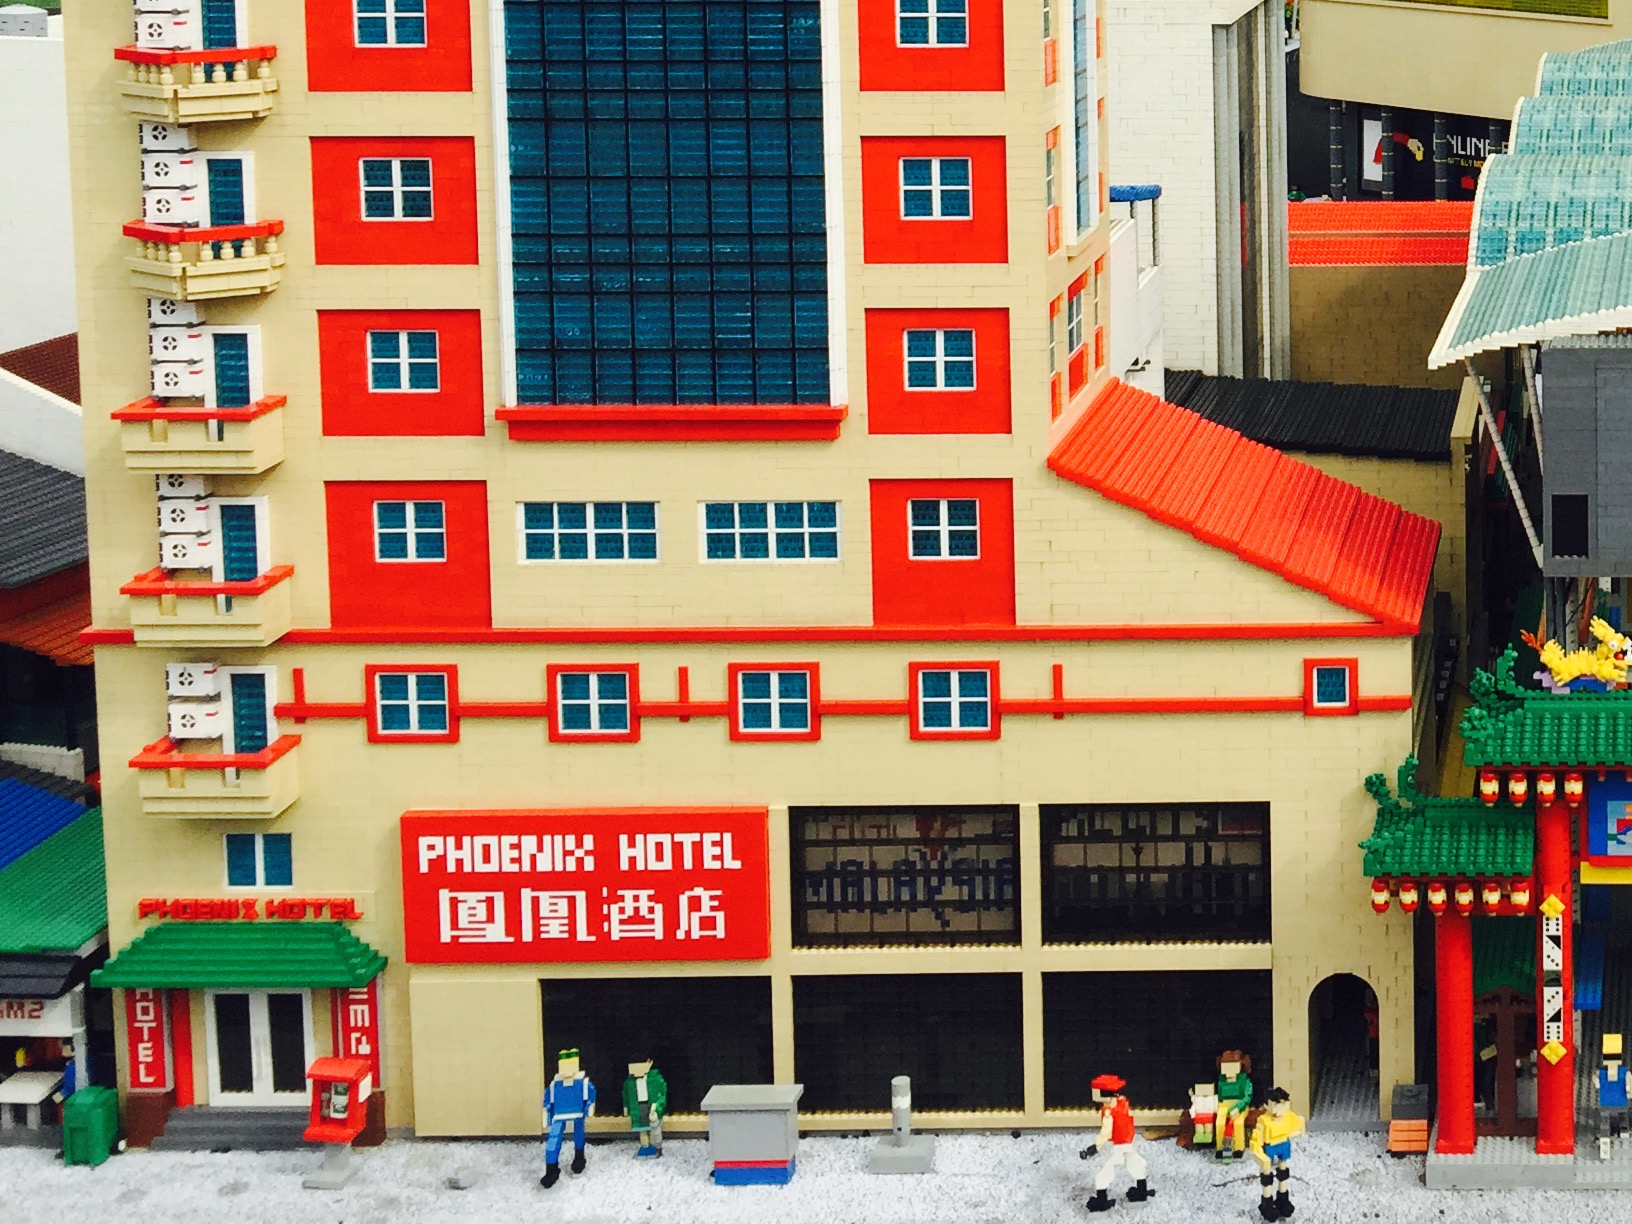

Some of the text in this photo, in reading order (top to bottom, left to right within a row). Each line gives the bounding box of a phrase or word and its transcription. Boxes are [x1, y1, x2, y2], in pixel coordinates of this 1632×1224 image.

[418, 832, 742, 874] PHOENIX HOTEL
[138, 898, 365, 920] PHOENIX HOTEL
[0, 999, 45, 1020] M2
